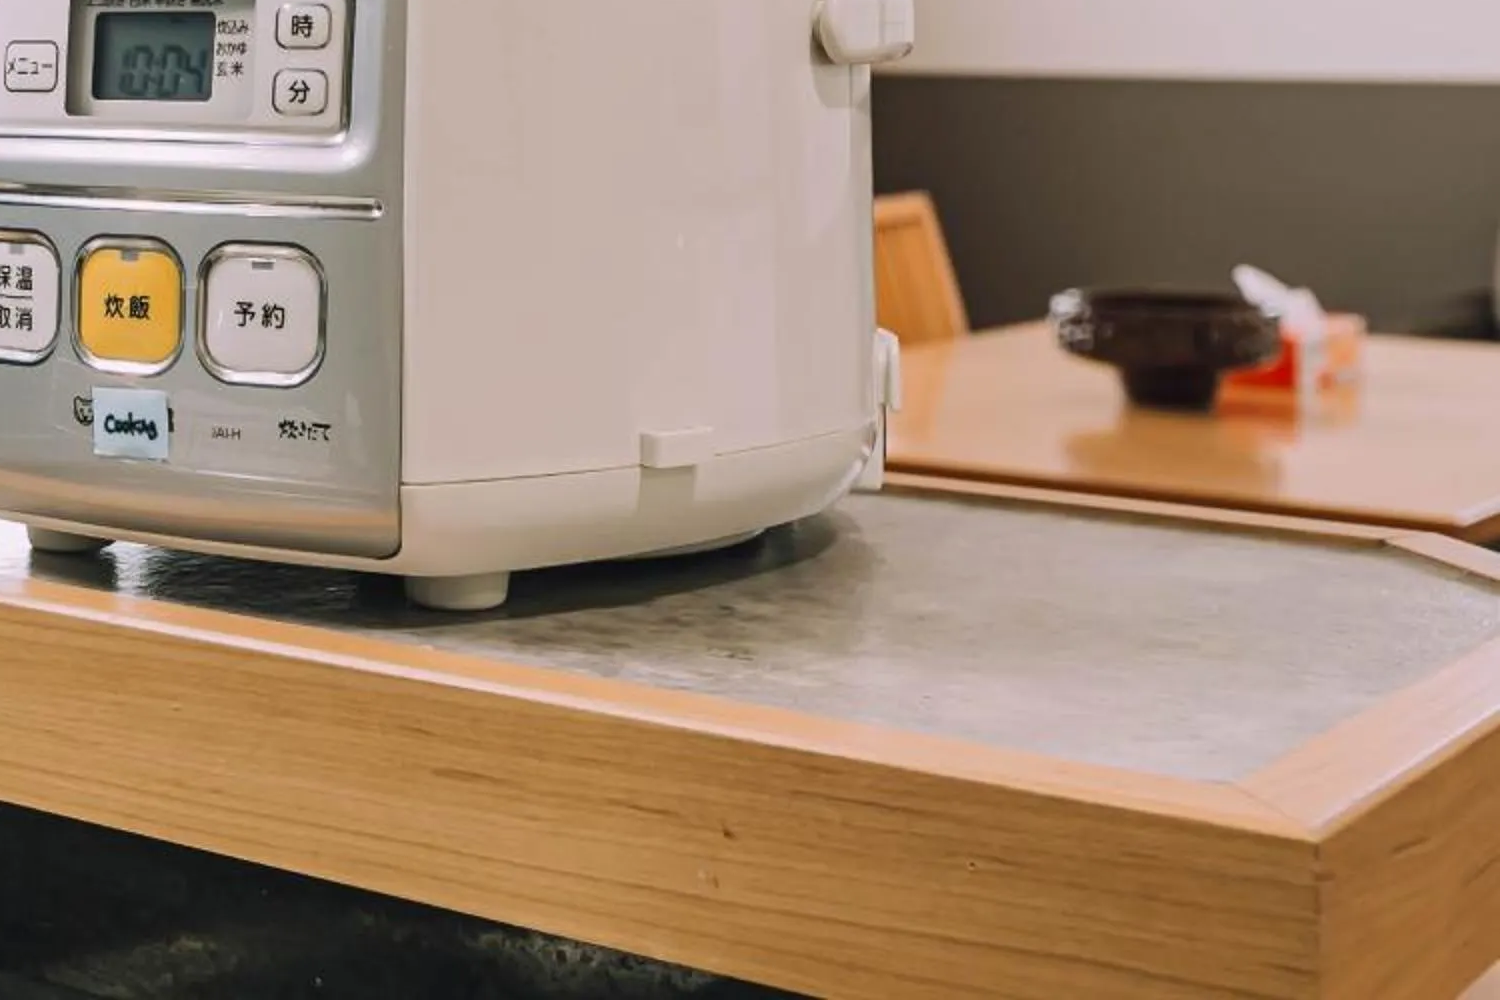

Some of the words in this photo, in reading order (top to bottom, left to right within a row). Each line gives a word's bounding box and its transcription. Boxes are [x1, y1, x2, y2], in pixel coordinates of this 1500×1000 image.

[290, 14, 314, 38] 時
[6, 57, 53, 75] メニュー
[288, 79, 311, 104] 分
[103, 293, 151, 320] 炊飯
[233, 301, 286, 329] 予約
